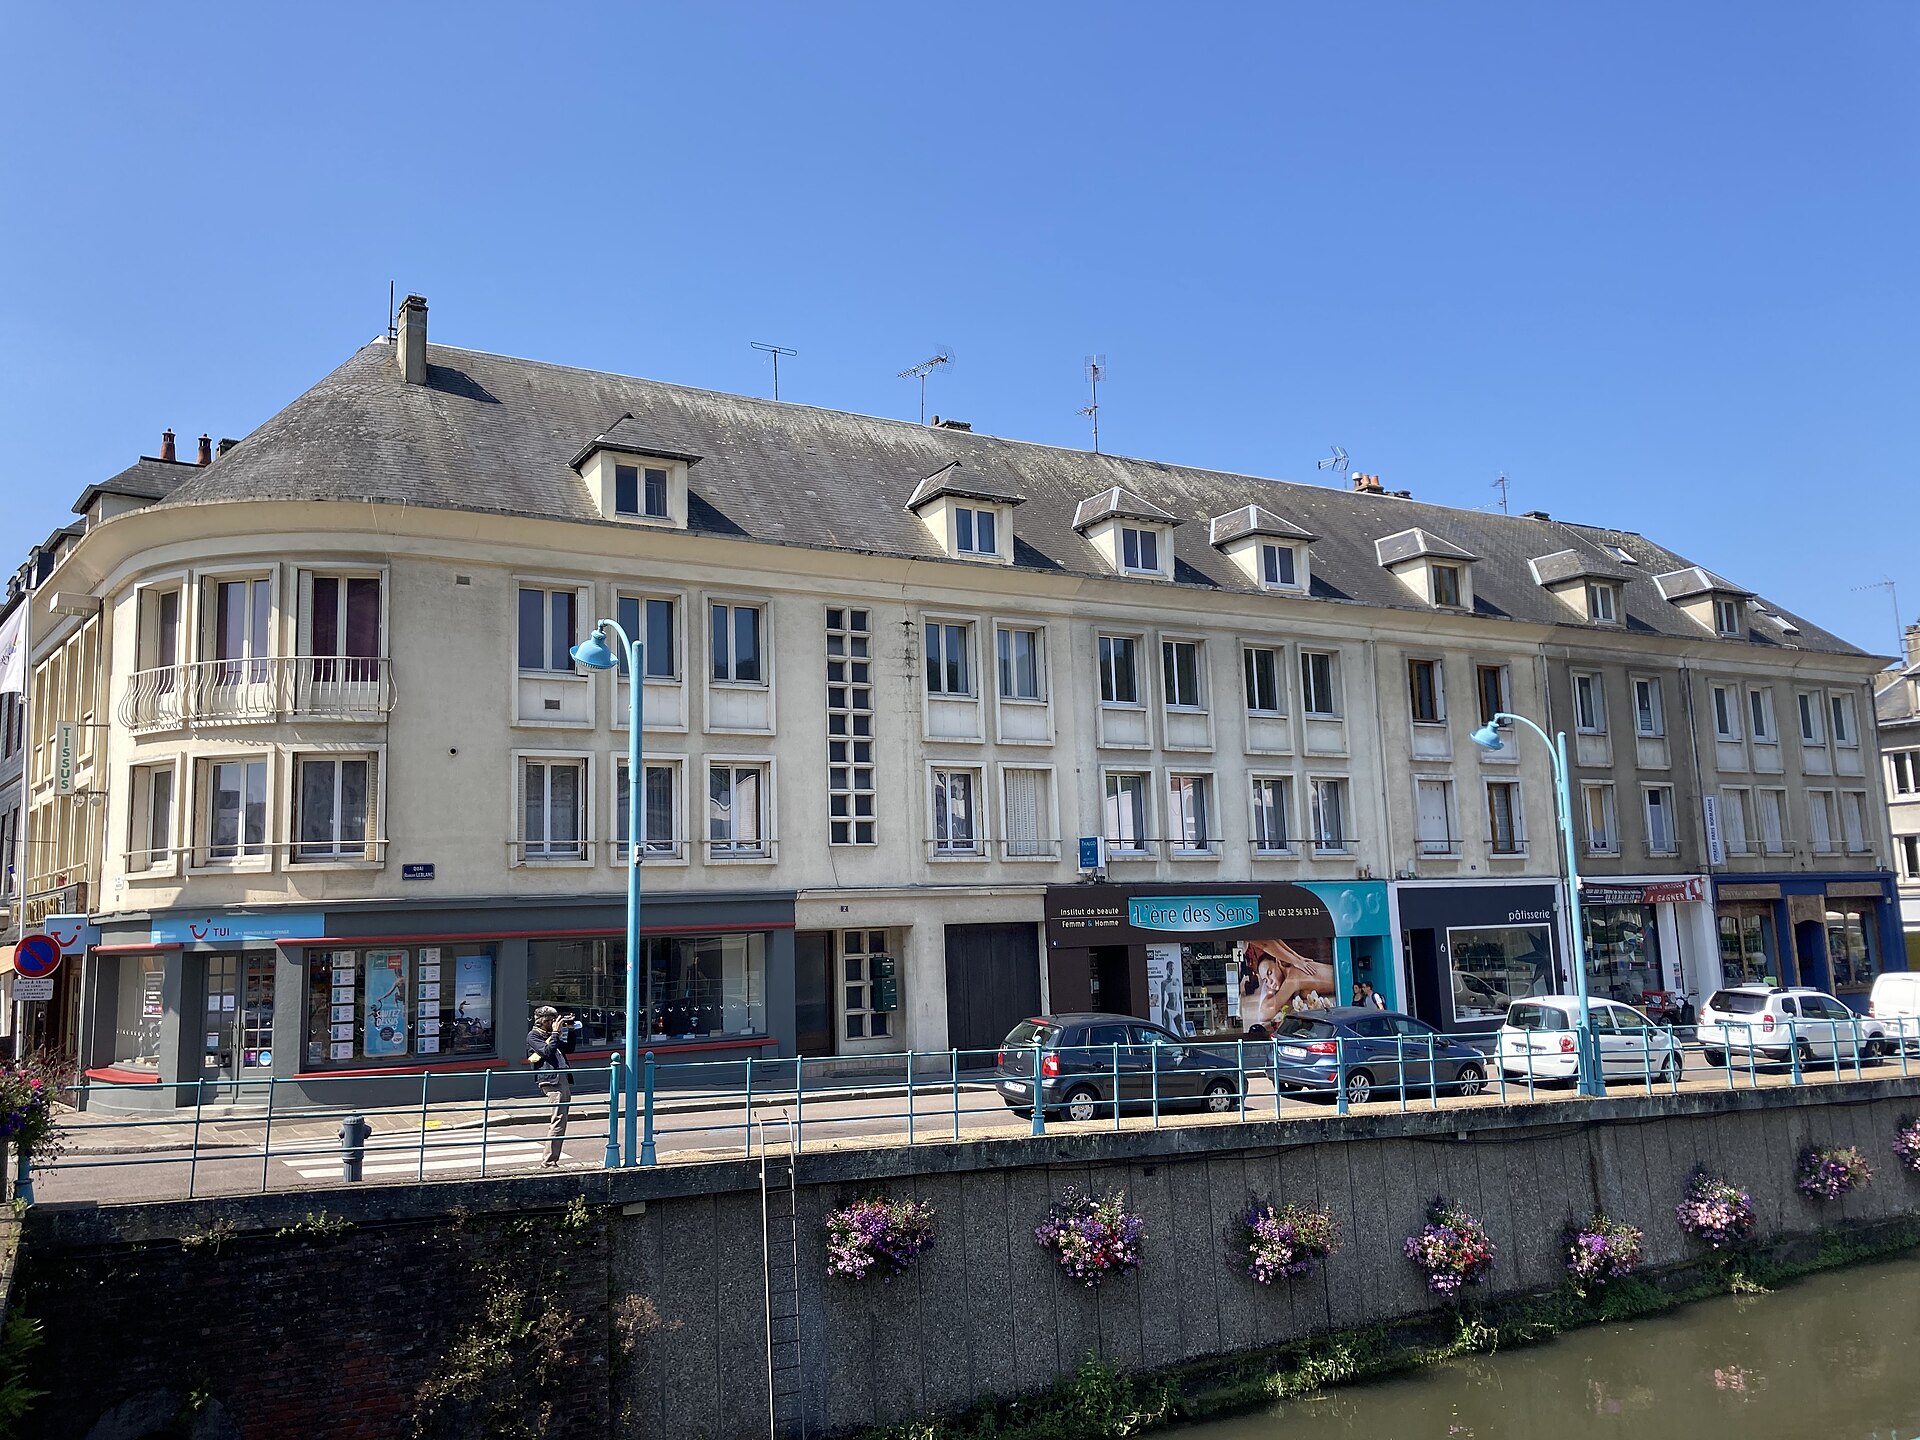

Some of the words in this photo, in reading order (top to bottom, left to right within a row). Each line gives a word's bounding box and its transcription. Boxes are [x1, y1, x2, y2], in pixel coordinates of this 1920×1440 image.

[61, 727, 71, 789] TISSUS
[1707, 798, 1715, 826] NORMANDIE
[1656, 892, 1685, 901] GAGNER
[1135, 903, 1177, 923] L'ère
[1183, 904, 1211, 922] des
[1215, 903, 1254, 922] Sens
[1295, 908, 1303, 916] 56
[1312, 907, 1319, 915] 33
[1508, 909, 1551, 922] pâtisserie
[1062, 920, 1085, 928] Femme
[213, 928, 230, 937] TUI
[1440, 943, 1446, 952] 6
